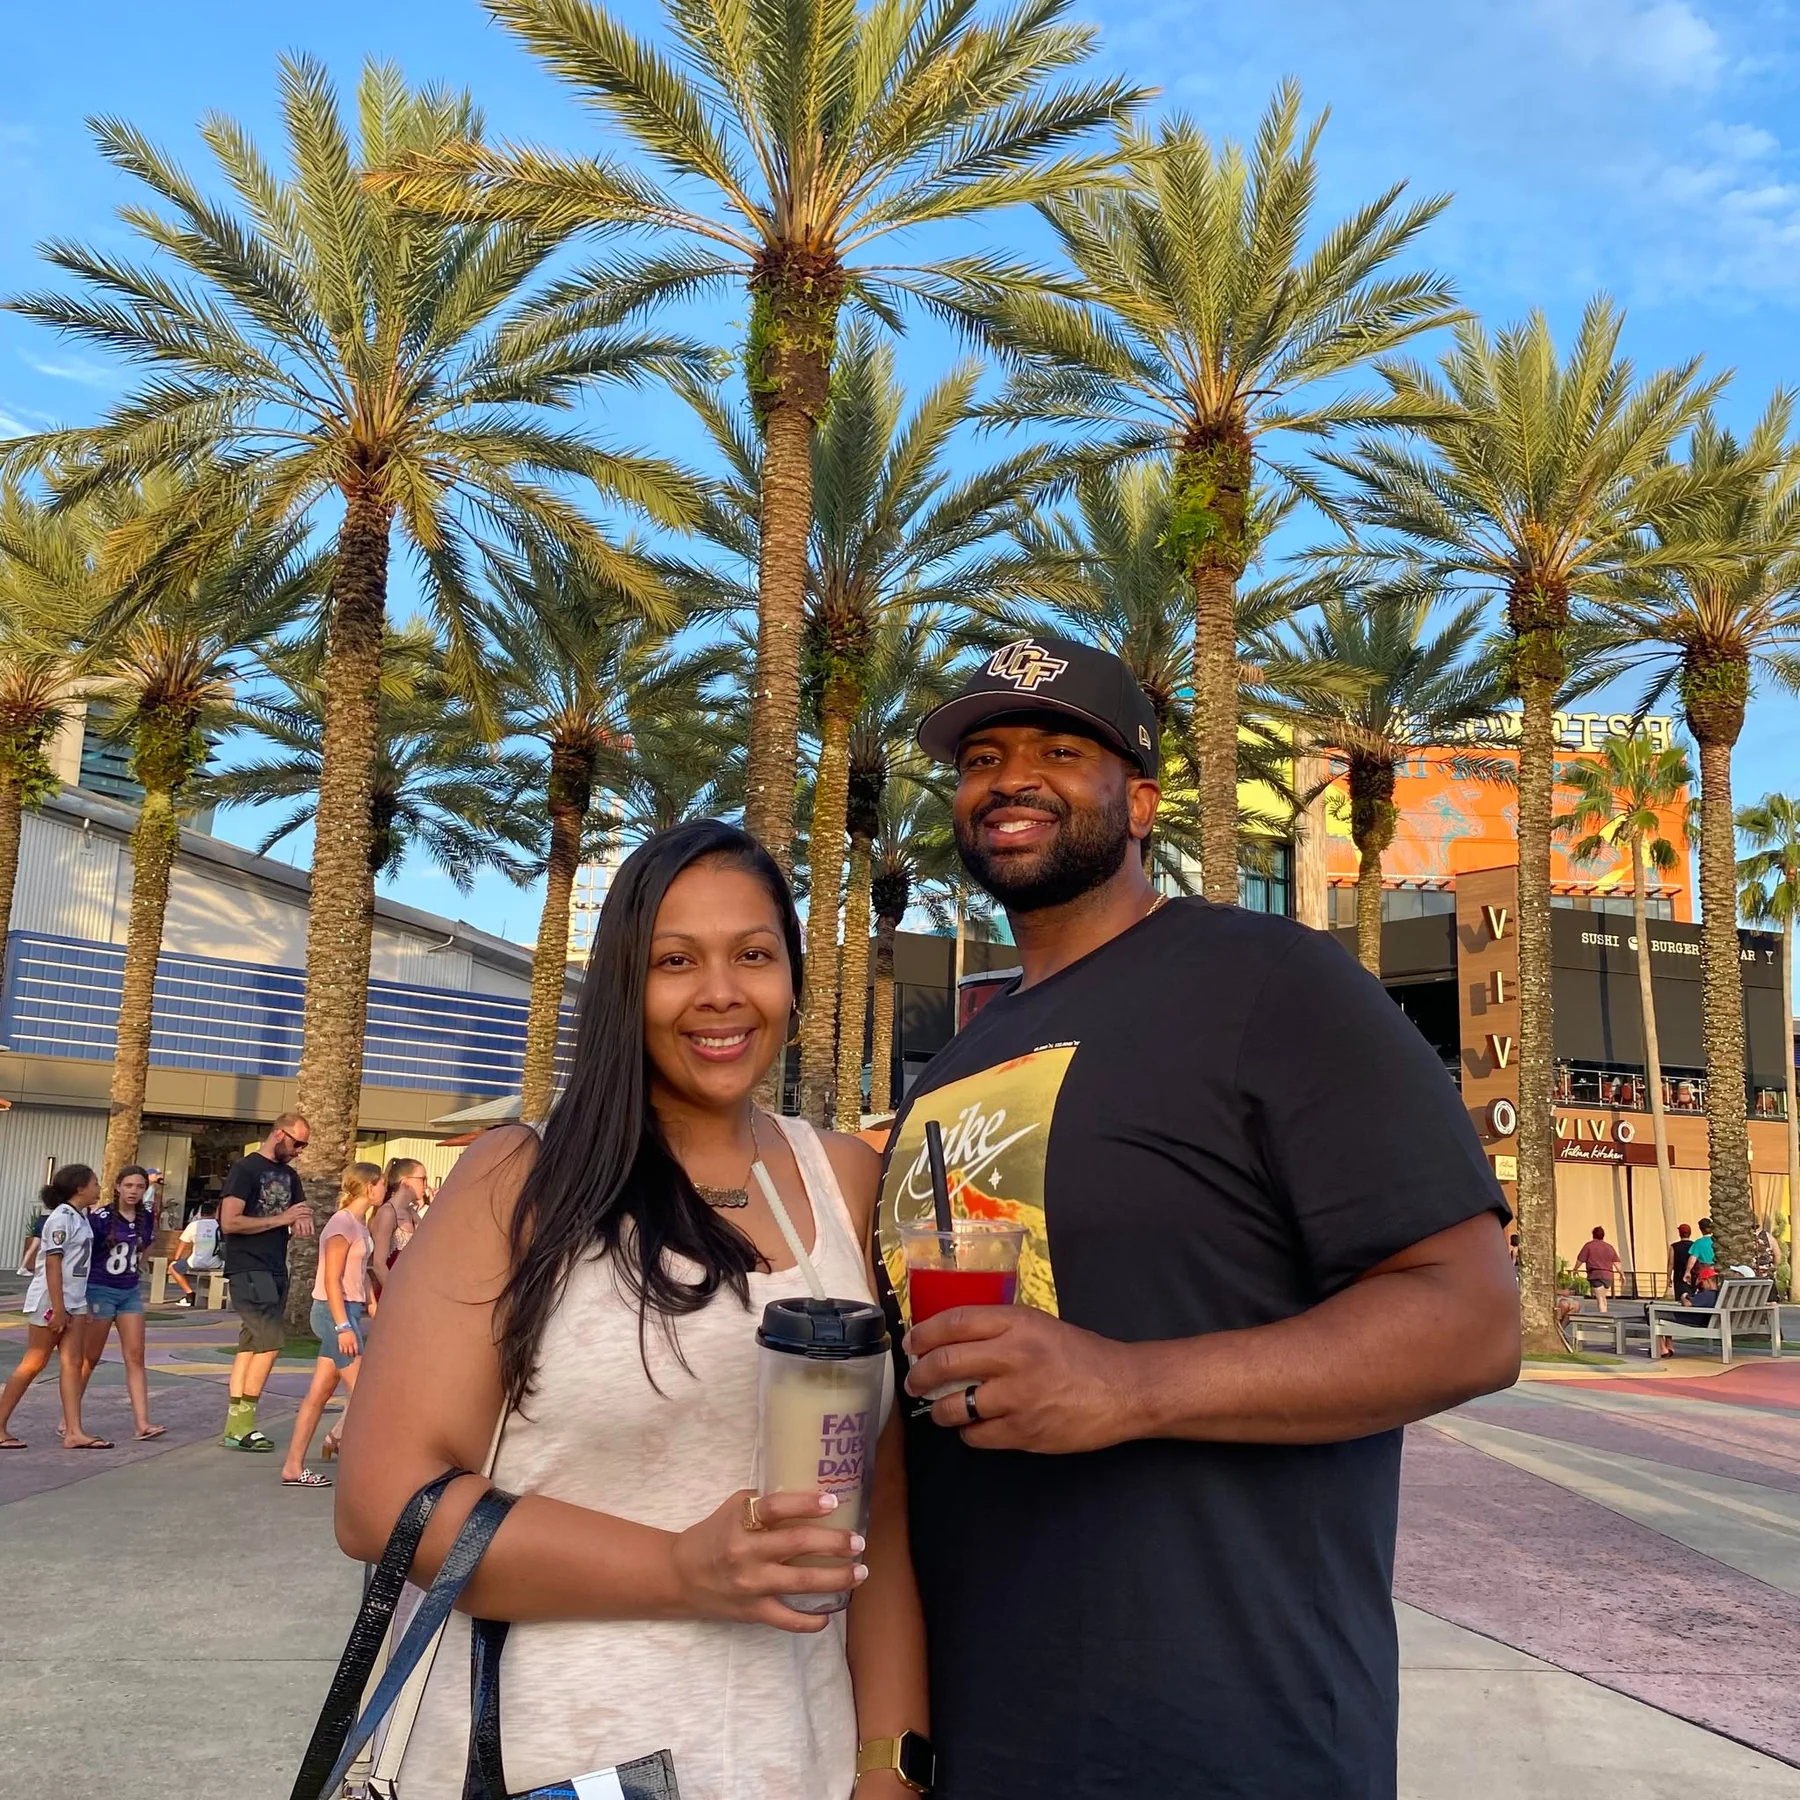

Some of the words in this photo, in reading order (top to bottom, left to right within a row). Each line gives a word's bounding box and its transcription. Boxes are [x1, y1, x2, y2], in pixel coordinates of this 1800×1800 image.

[986, 638, 1070, 692] UCF
[1581, 932, 1620, 948] SUSHI
[1650, 940, 1701, 957] BURGER
[1736, 948, 1757, 962] AR
[1488, 904, 1518, 1137] VIVO
[1555, 1117, 1636, 1143] VIVO
[822, 1411, 870, 1435] FAT
[818, 1456, 863, 1477] DAY
